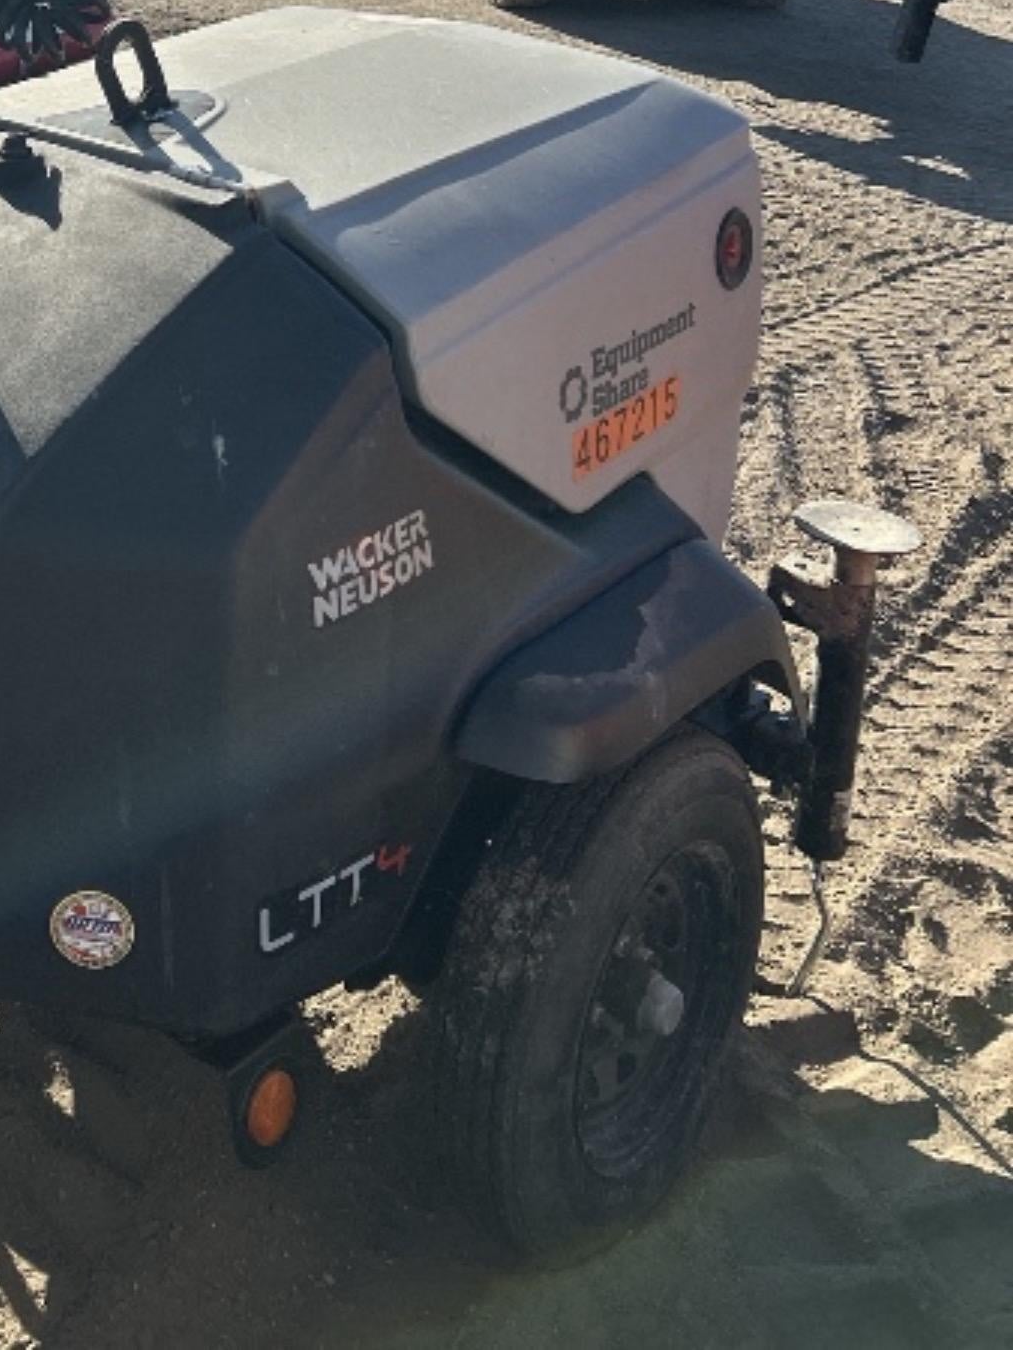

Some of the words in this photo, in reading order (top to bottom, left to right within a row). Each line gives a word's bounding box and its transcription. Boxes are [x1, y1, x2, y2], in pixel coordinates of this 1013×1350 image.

[591, 302, 696, 378] Equipment
[574, 376, 679, 473] 467215
[592, 367, 649, 417] Share
[307, 509, 429, 592] WACKER
[313, 539, 435, 628] NEUSON
